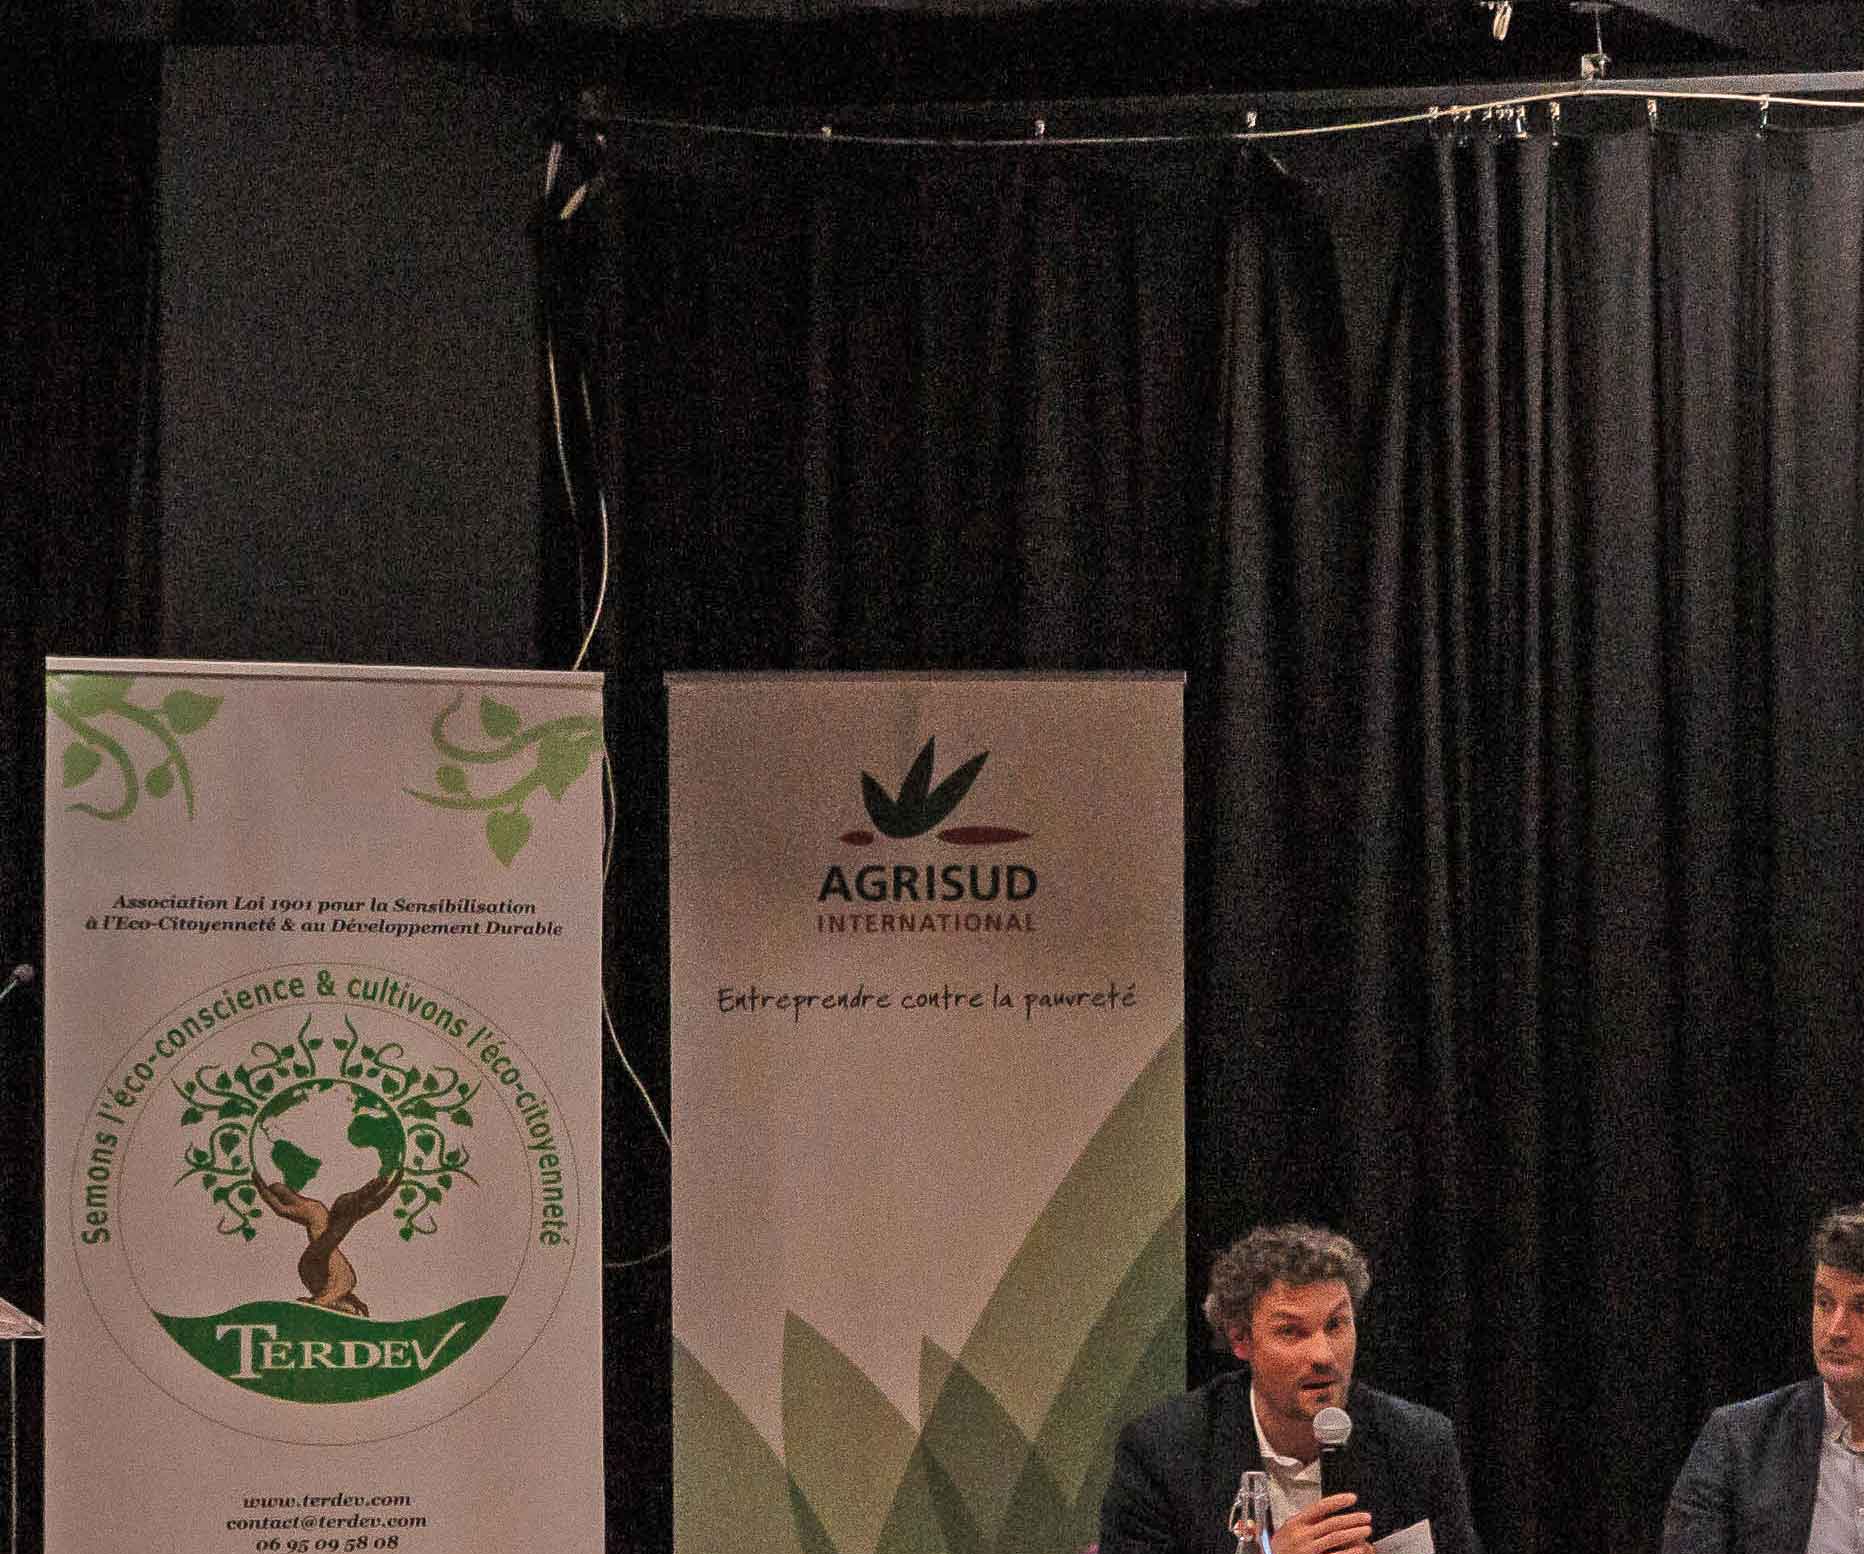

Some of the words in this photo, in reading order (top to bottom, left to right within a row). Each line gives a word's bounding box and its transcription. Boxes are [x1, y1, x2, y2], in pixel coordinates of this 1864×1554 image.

[818, 864, 1037, 902] AGRISUD
[112, 895, 228, 910] Association
[234, 896, 266, 911] Loi
[271, 900, 312, 913] 1901
[317, 900, 366, 915] pour
[371, 897, 388, 913] la
[393, 897, 536, 914] Sensibilisation
[86, 916, 97, 930] à
[103, 915, 276, 934] l'Eco-Citoyenneté
[281, 917, 295, 932] &
[301, 921, 326, 933] au
[331, 918, 481, 937] Développement
[485, 920, 563, 936] Durable
[817, 912, 1036, 934] INTERNATIONAL
[717, 985, 892, 1022] Entreprendre
[900, 984, 984, 1012] contre
[993, 984, 1013, 1010] la
[1023, 982, 1138, 1020] pauvreté
[81, 1131, 119, 1245] Semons
[316, 969, 336, 997] &
[347, 976, 469, 1038] cultivons
[243, 1492, 410, 1509] www.terdev.com
[226, 1513, 427, 1531] contact@terdev.com
[256, 1535, 280, 1552] 06
[286, 1539, 309, 1553] 95
[315, 1538, 339, 1553] 09
[344, 1536, 369, 1552] 58
[374, 1535, 399, 1550] 08
